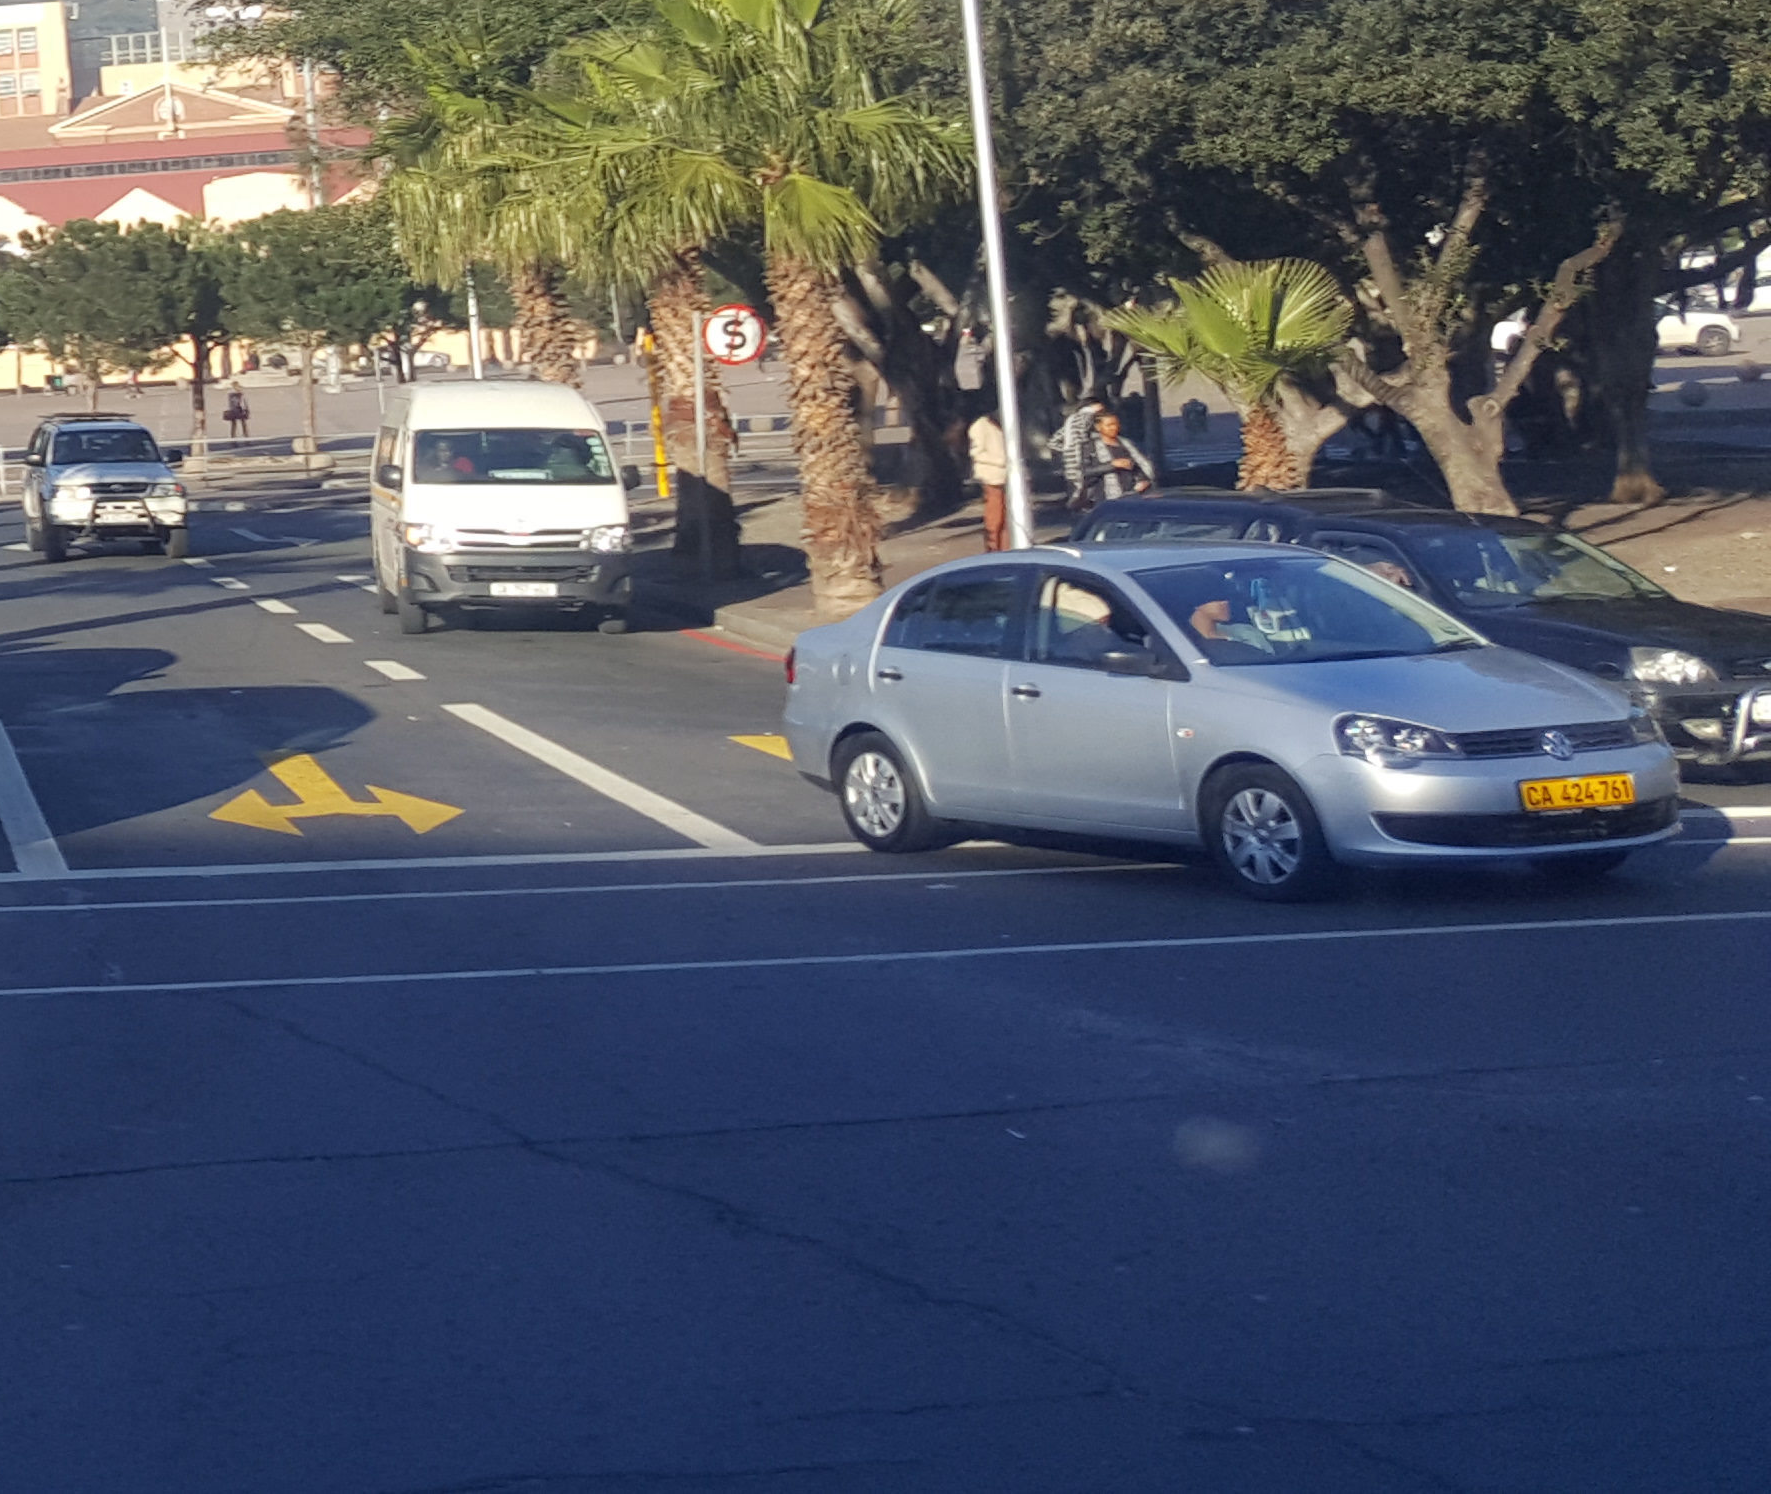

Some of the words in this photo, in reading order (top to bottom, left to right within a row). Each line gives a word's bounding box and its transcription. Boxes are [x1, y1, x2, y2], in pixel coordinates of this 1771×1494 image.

[722, 319, 747, 350] S
[1525, 786, 1555, 806] CA
[1560, 779, 1631, 804] 424-761
